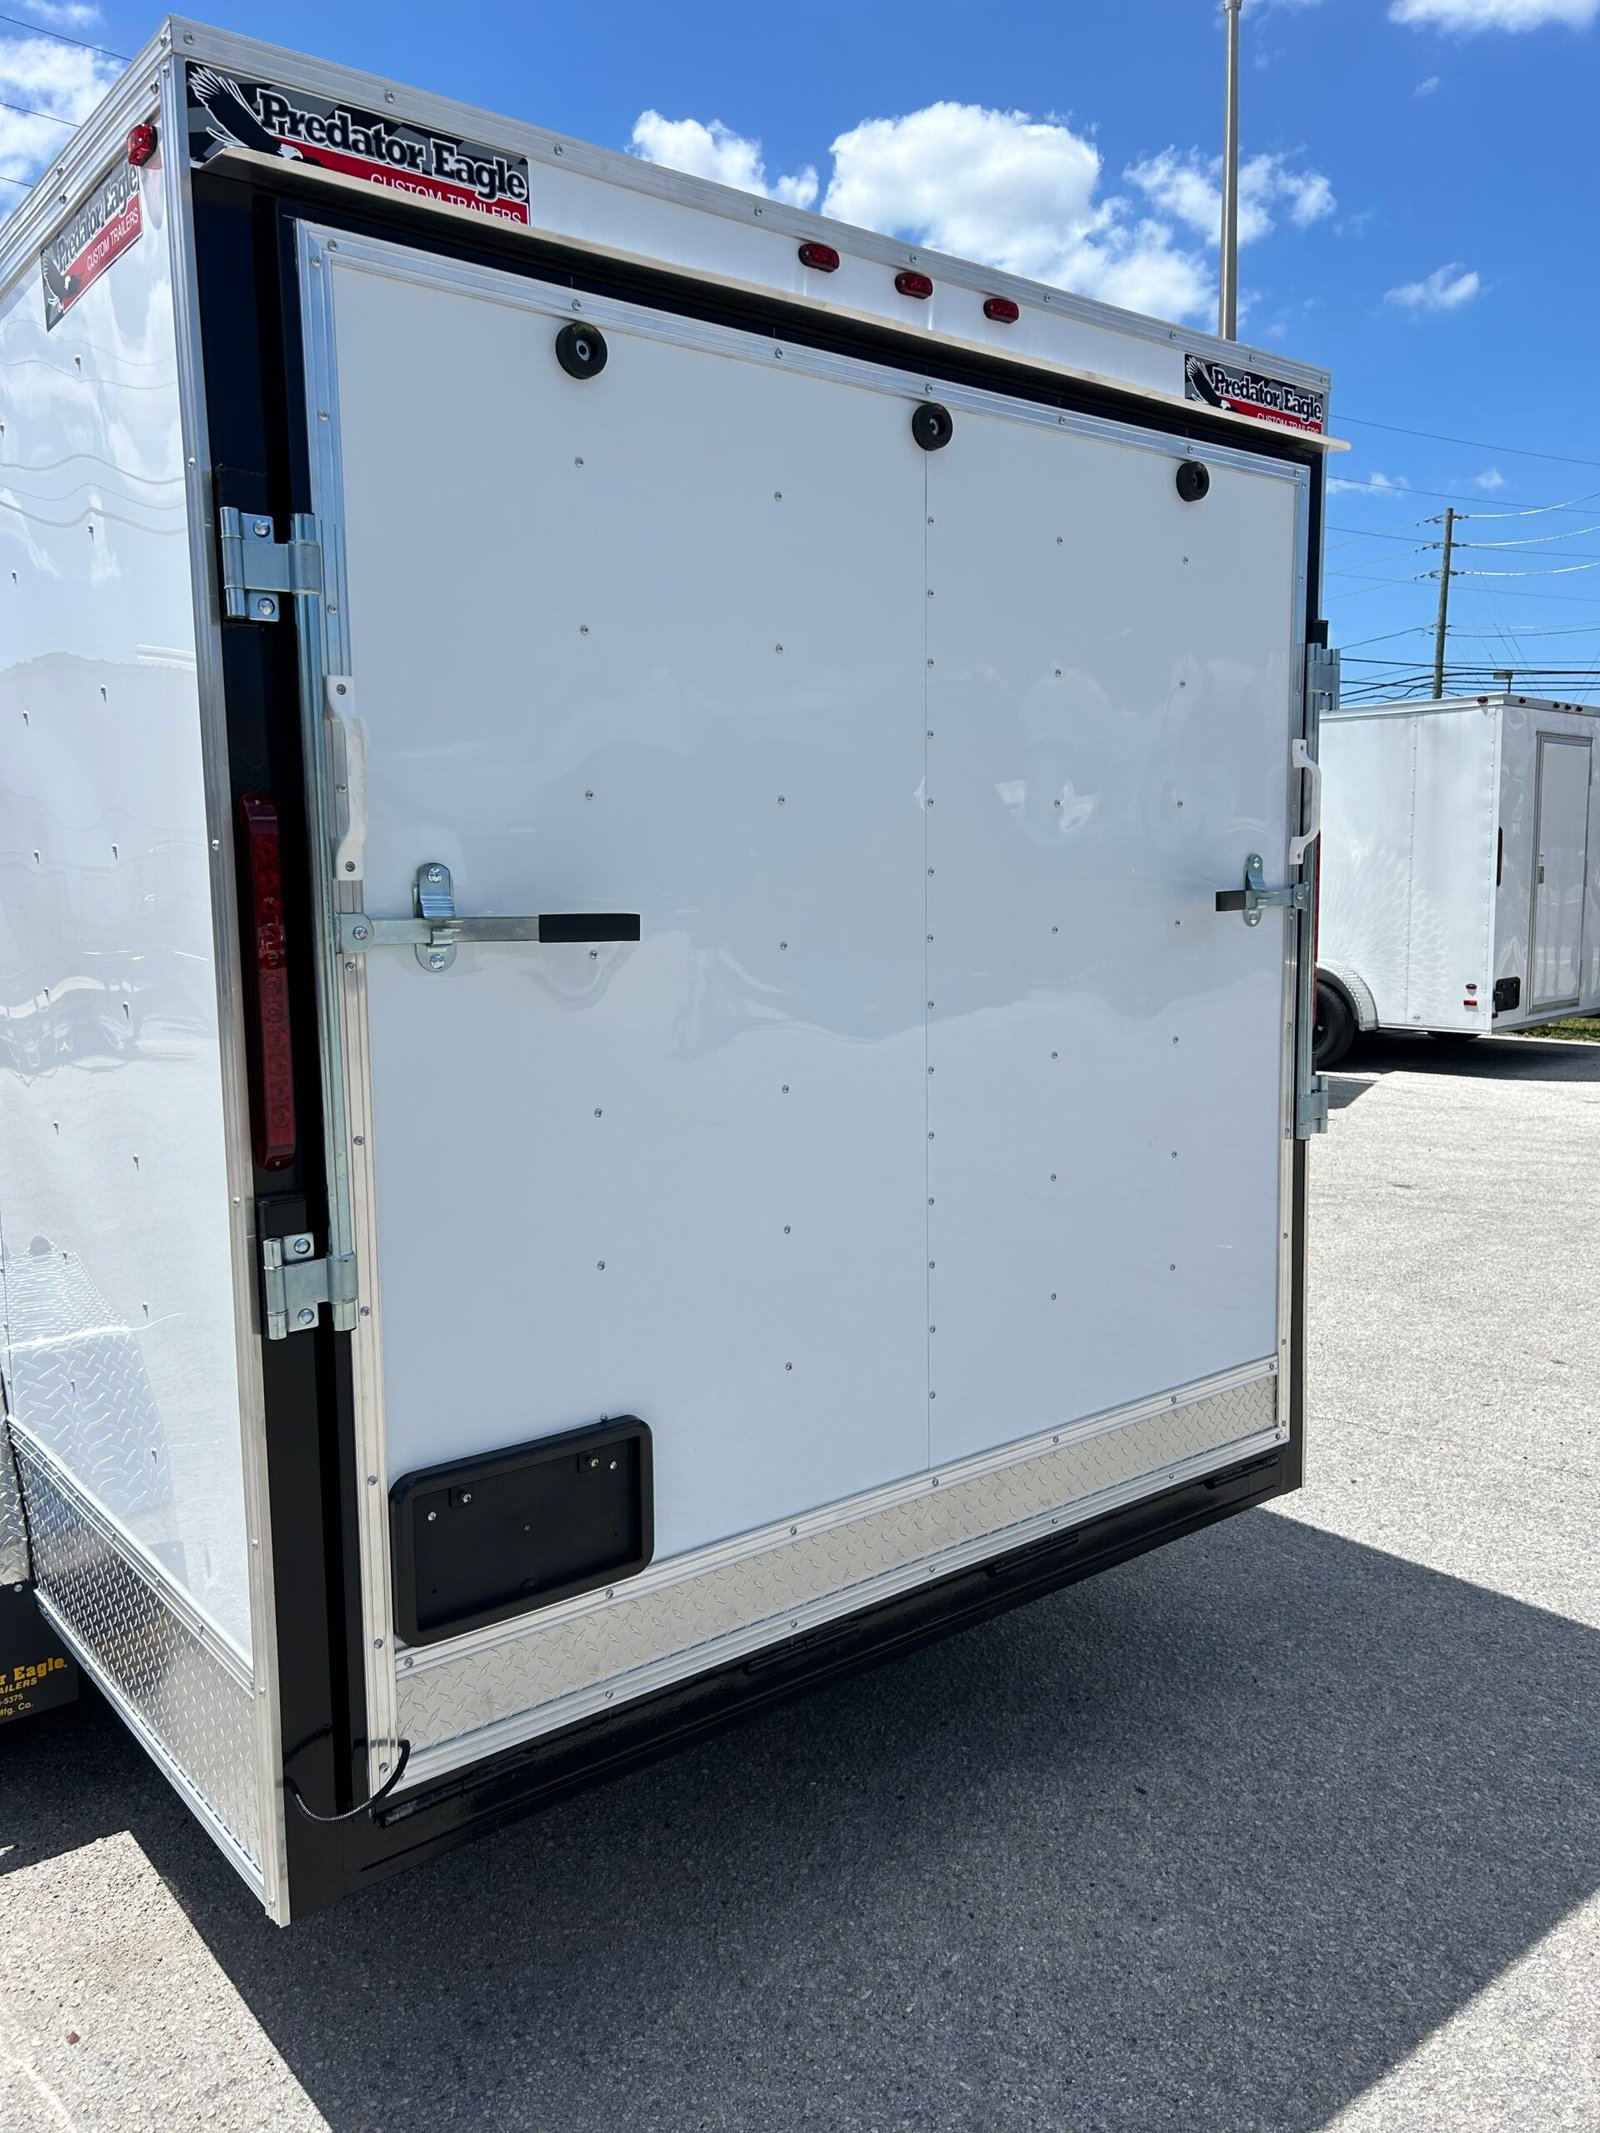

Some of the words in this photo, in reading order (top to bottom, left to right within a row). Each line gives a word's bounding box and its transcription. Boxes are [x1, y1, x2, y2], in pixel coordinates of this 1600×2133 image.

[256, 87, 426, 174] Predator
[430, 138, 528, 203] Eagle
[57, 202, 105, 276] Predator
[102, 160, 139, 220] Eagle
[86, 236, 110, 271] CUSTOM
[110, 206, 139, 246] TRAILERS
[1212, 366, 1281, 409] Predator
[1283, 387, 1323, 424] Eagle
[0, 1677, 38, 1694] AILERS
